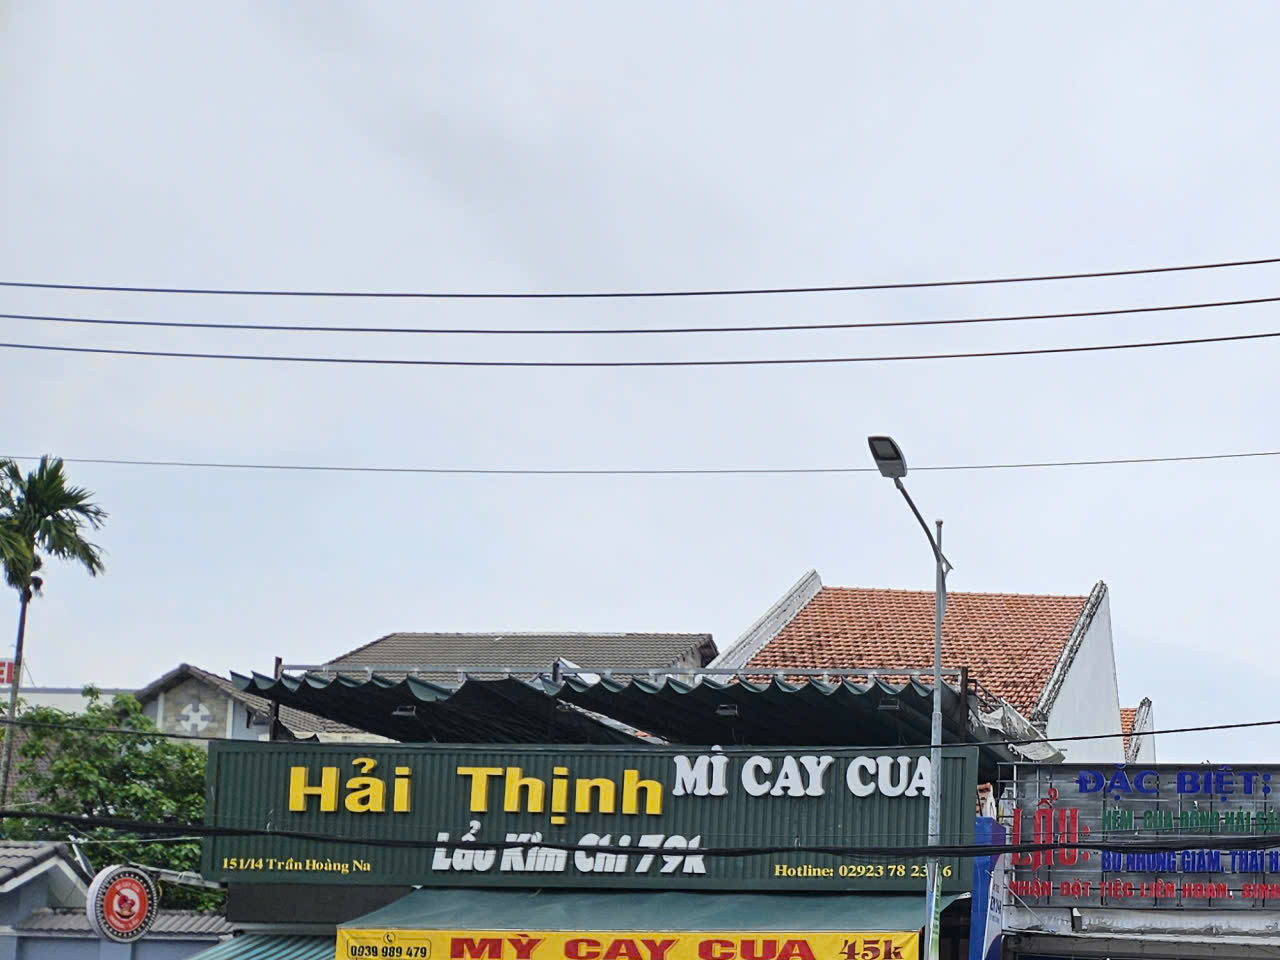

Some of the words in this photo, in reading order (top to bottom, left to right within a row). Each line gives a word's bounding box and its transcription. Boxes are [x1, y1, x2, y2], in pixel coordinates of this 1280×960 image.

[288, 757, 412, 813] Hải
[457, 766, 663, 825] Thịnh
[741, 755, 834, 797] CAY
[846, 755, 931, 797] CUA
[1077, 763, 1160, 801] ĐẶC
[1176, 766, 1272, 803] BIỆT:
[222, 857, 264, 870] 151/14
[305, 858, 350, 876] Hoàng
[352, 859, 372, 873] Na
[574, 833, 632, 873] Chi
[774, 864, 834, 877] Hotline:
[838, 864, 884, 877] 02923
[887, 865, 906, 877] 78
[350, 945, 378, 957] 0939
[381, 945, 402, 958] 989
[406, 946, 427, 958] 479
